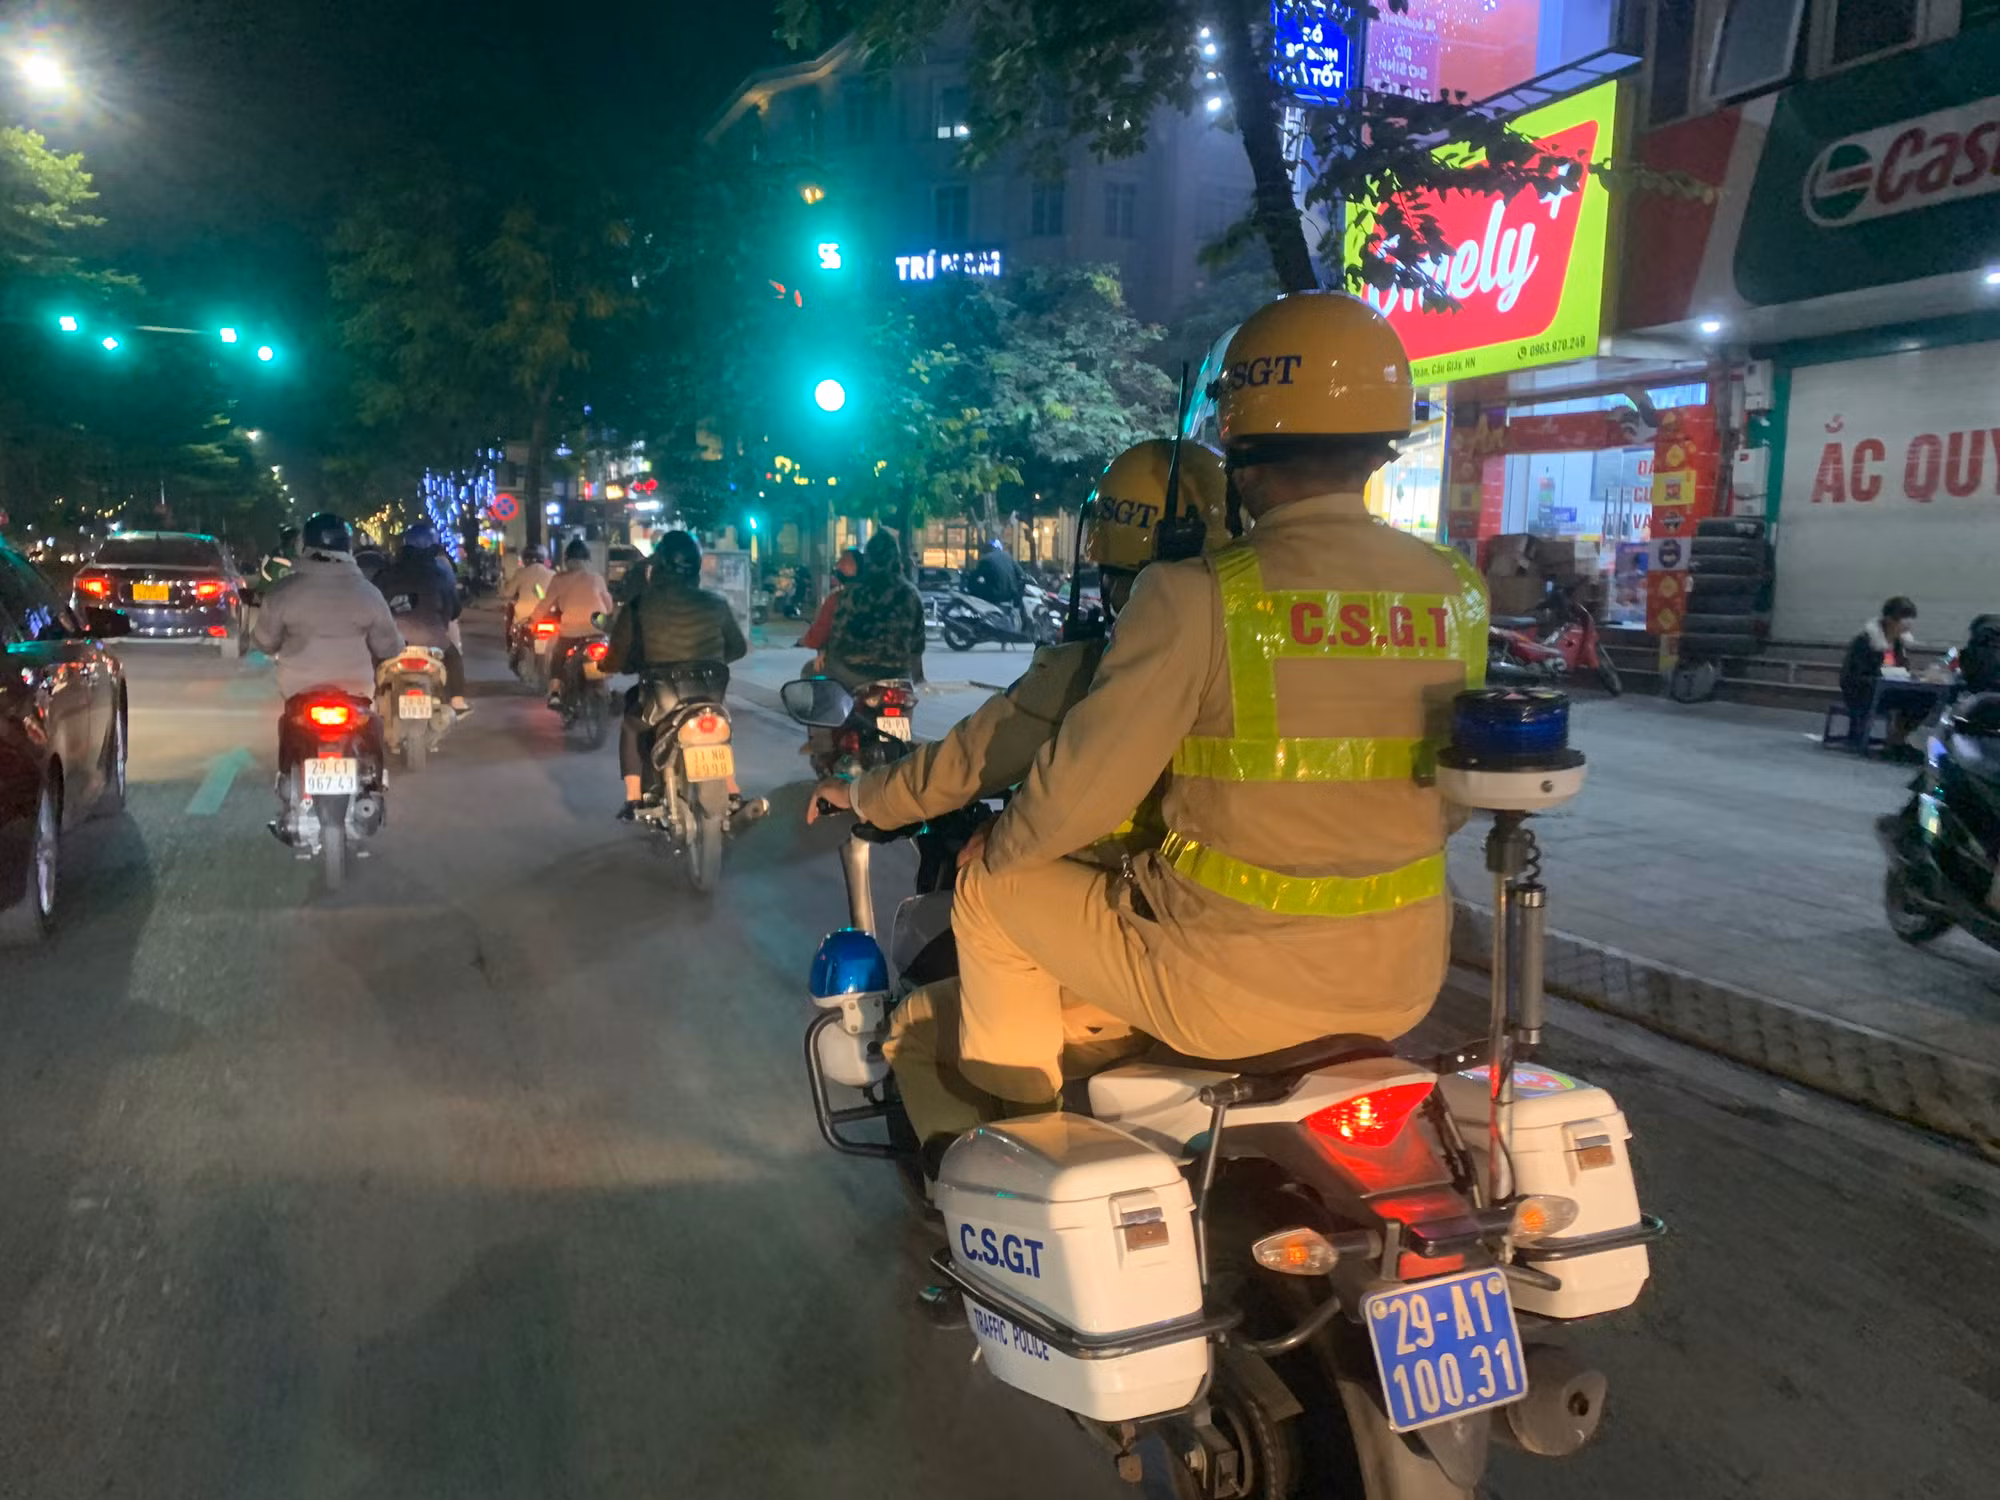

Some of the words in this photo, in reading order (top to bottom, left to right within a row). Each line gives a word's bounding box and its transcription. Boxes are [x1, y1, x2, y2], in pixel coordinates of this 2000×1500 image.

[896, 248, 937, 281] TRÍ
[1229, 354, 1302, 390] SGT
[1290, 602, 1449, 648] C.S.G.T
[960, 1223, 1044, 1279] C.S.G.T
[973, 1307, 1008, 1346] TRAFFIC
[1012, 1322, 1050, 1362] POLICE
[1389, 1280, 1493, 1356] 29-A1
[1393, 1338, 1517, 1420] 100.31
